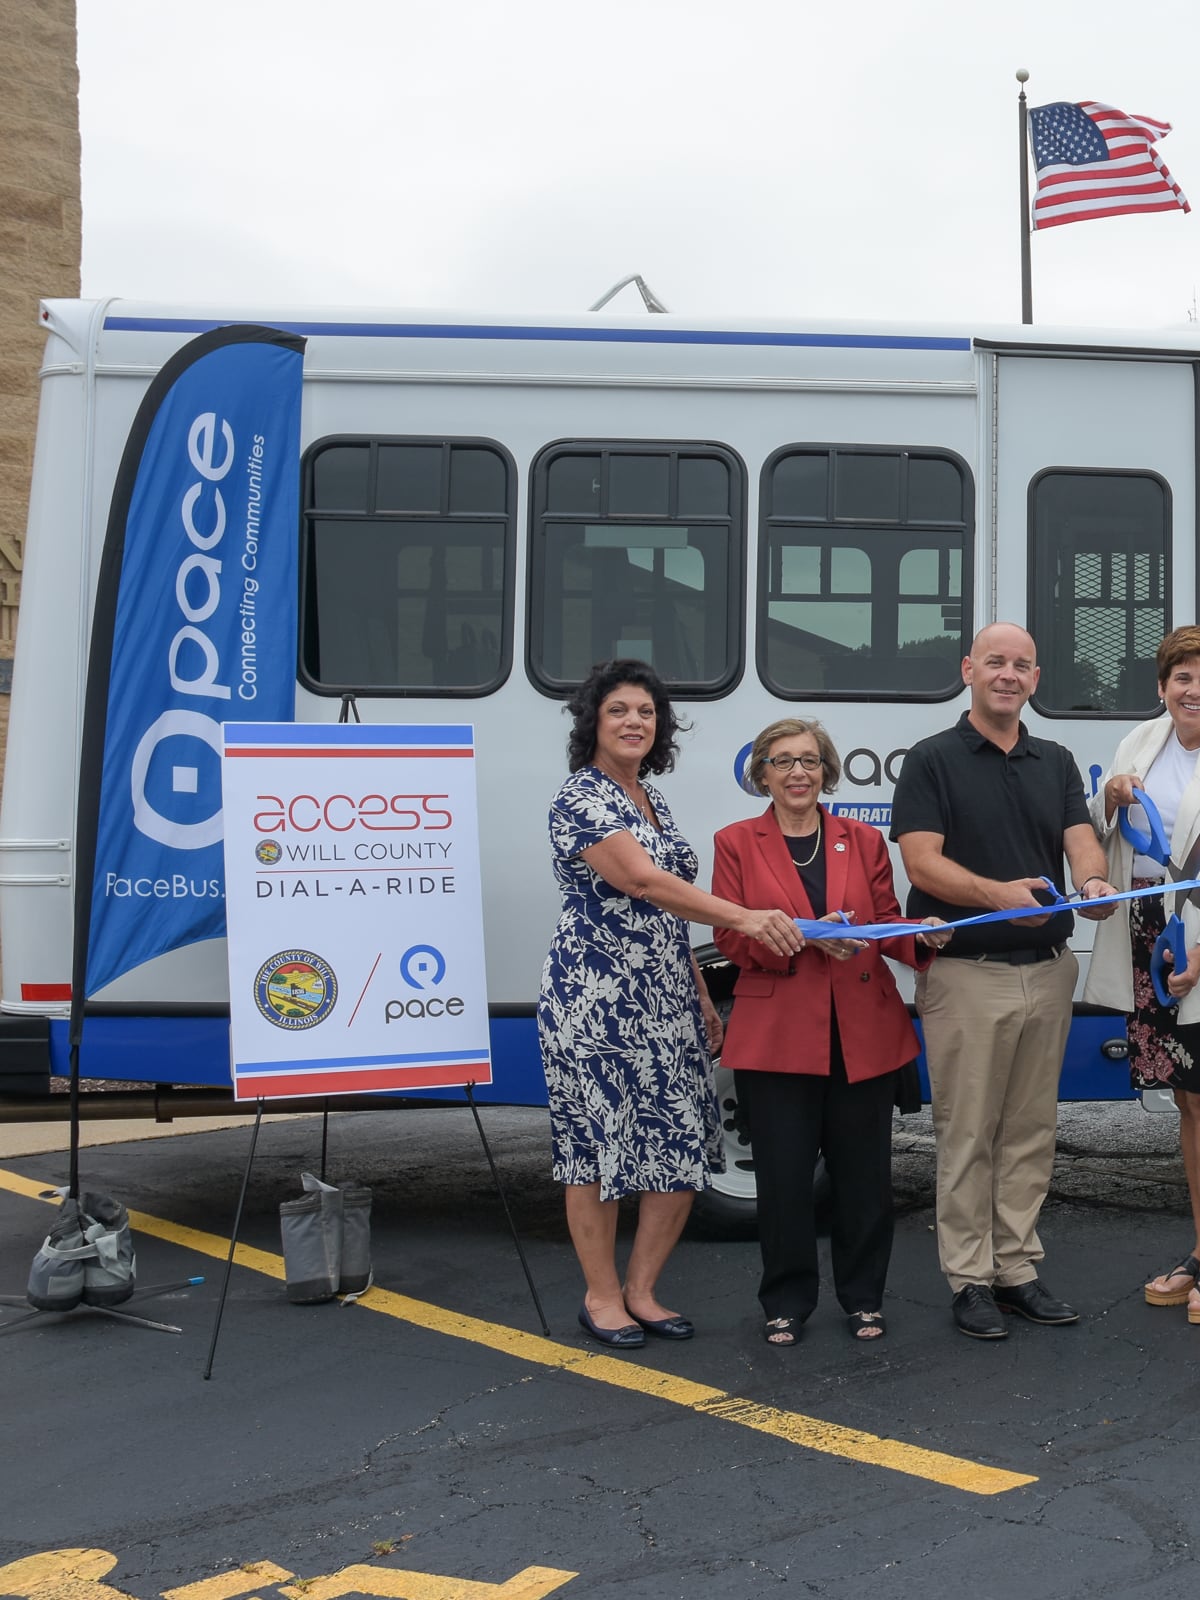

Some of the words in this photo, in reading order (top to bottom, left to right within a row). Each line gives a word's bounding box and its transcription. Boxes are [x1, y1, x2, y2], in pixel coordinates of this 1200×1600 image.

[241, 434, 265, 571] Communities
[168, 412, 235, 700] pace
[238, 576, 260, 701] Connecting
[253, 794, 454, 833] access
[286, 844, 346, 862] WILL
[354, 842, 453, 861] COUNTY
[105, 872, 226, 898] PaceBus.
[256, 876, 456, 898] DIAL-A-RIDE
[260, 967, 272, 985] THE
[269, 954, 302, 970] COUNTY
[303, 955, 315, 964] OF
[315, 961, 330, 981] WILL
[279, 1013, 318, 1026] ILLINOIS
[385, 997, 465, 1024] pace
